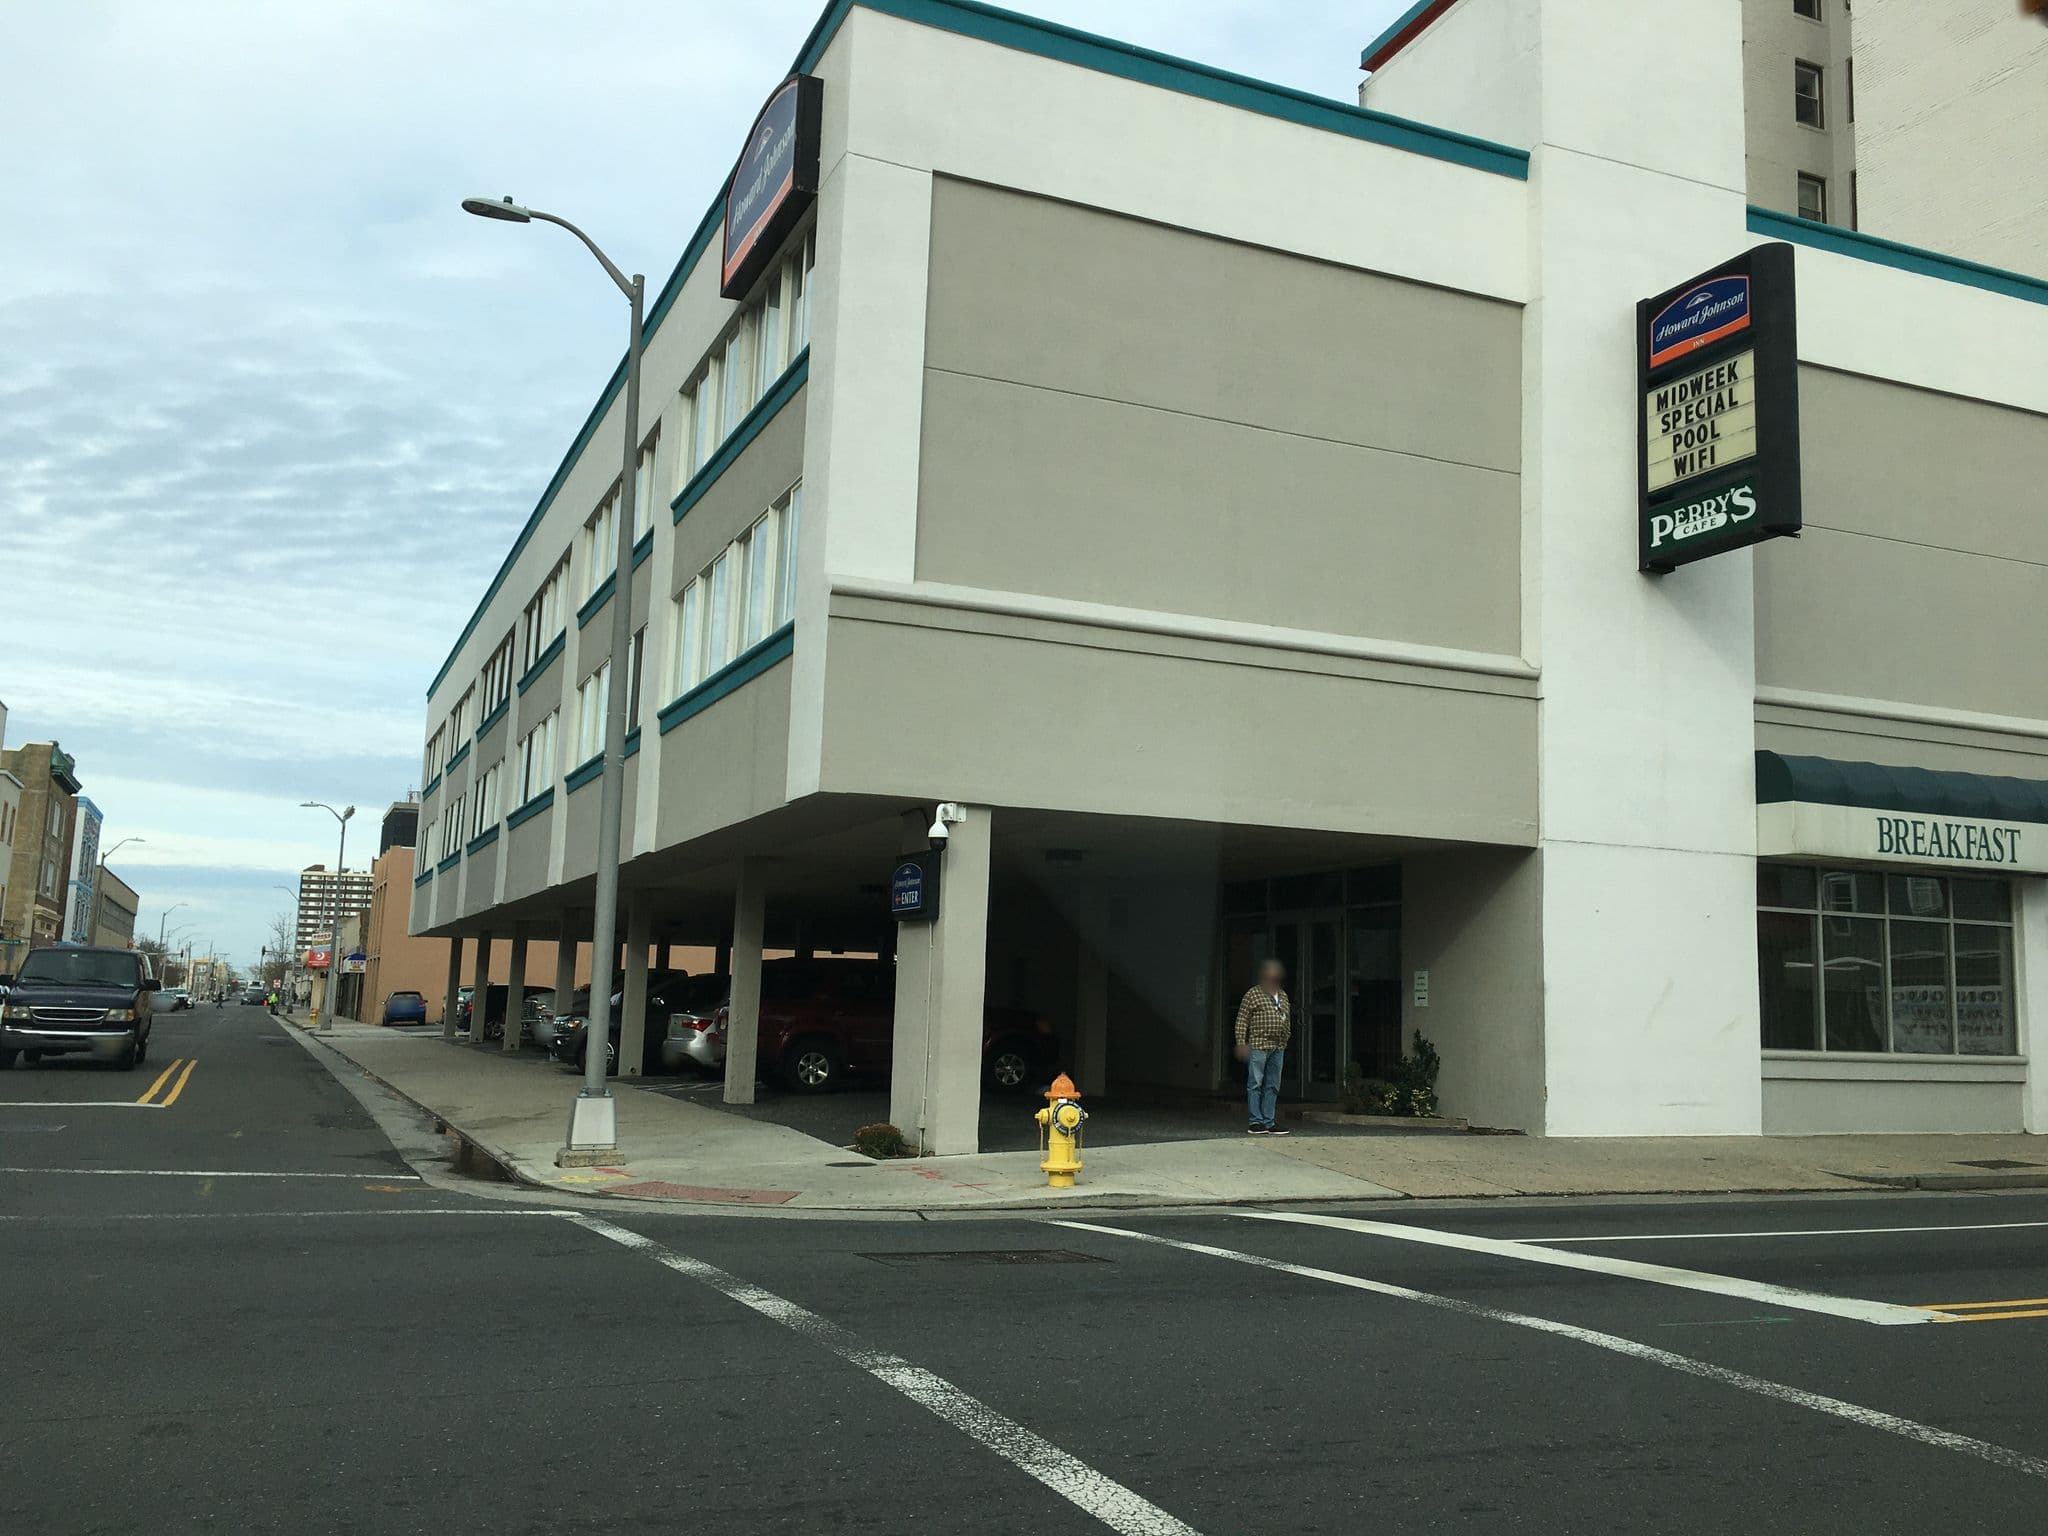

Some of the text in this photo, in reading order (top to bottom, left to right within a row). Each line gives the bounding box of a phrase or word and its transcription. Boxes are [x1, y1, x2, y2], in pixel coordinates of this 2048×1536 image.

[730, 168, 763, 237] Howard
[761, 117, 795, 193] Johnson
[1656, 291, 1745, 342] Howard Johnson
[1692, 339, 1705, 349] INN
[1656, 361, 1738, 412] MIDWEEK
[1661, 388, 1738, 433] SPECIAL
[1673, 420, 1720, 453] POOL
[1674, 445, 1715, 477] WIFI
[1651, 485, 1757, 548] PERRY'S
[1877, 817, 2021, 863] BREAKFAST
[902, 891, 919, 904] ENTER
